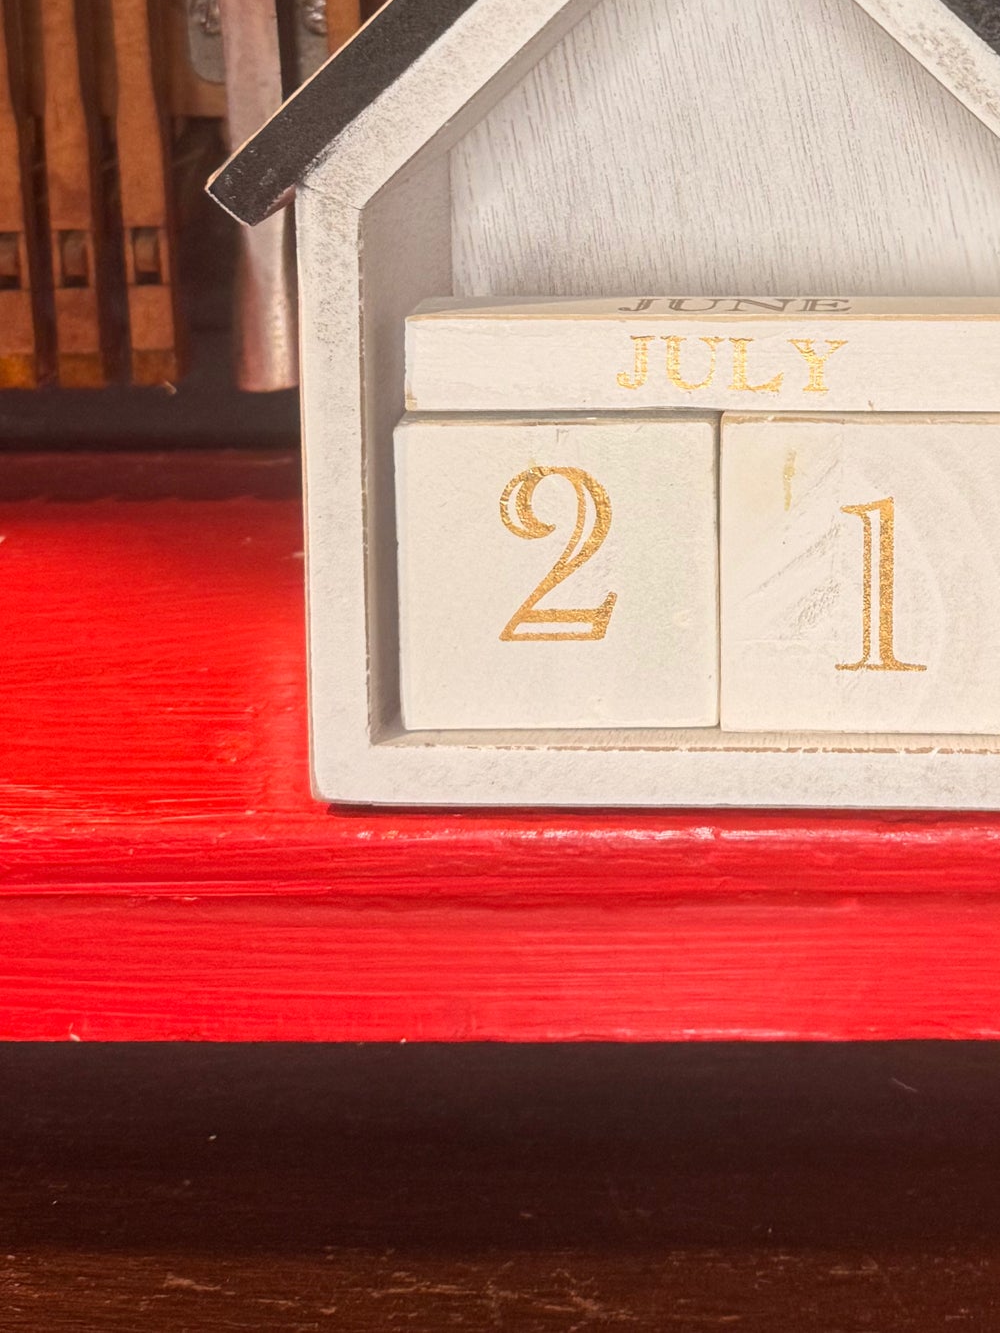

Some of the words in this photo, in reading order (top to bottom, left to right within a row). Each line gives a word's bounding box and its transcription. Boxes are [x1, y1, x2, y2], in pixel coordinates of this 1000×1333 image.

[617, 297, 852, 313] JUNE
[616, 335, 849, 392] JULY
[498, 465, 618, 642] 2
[834, 496, 927, 671] 1
